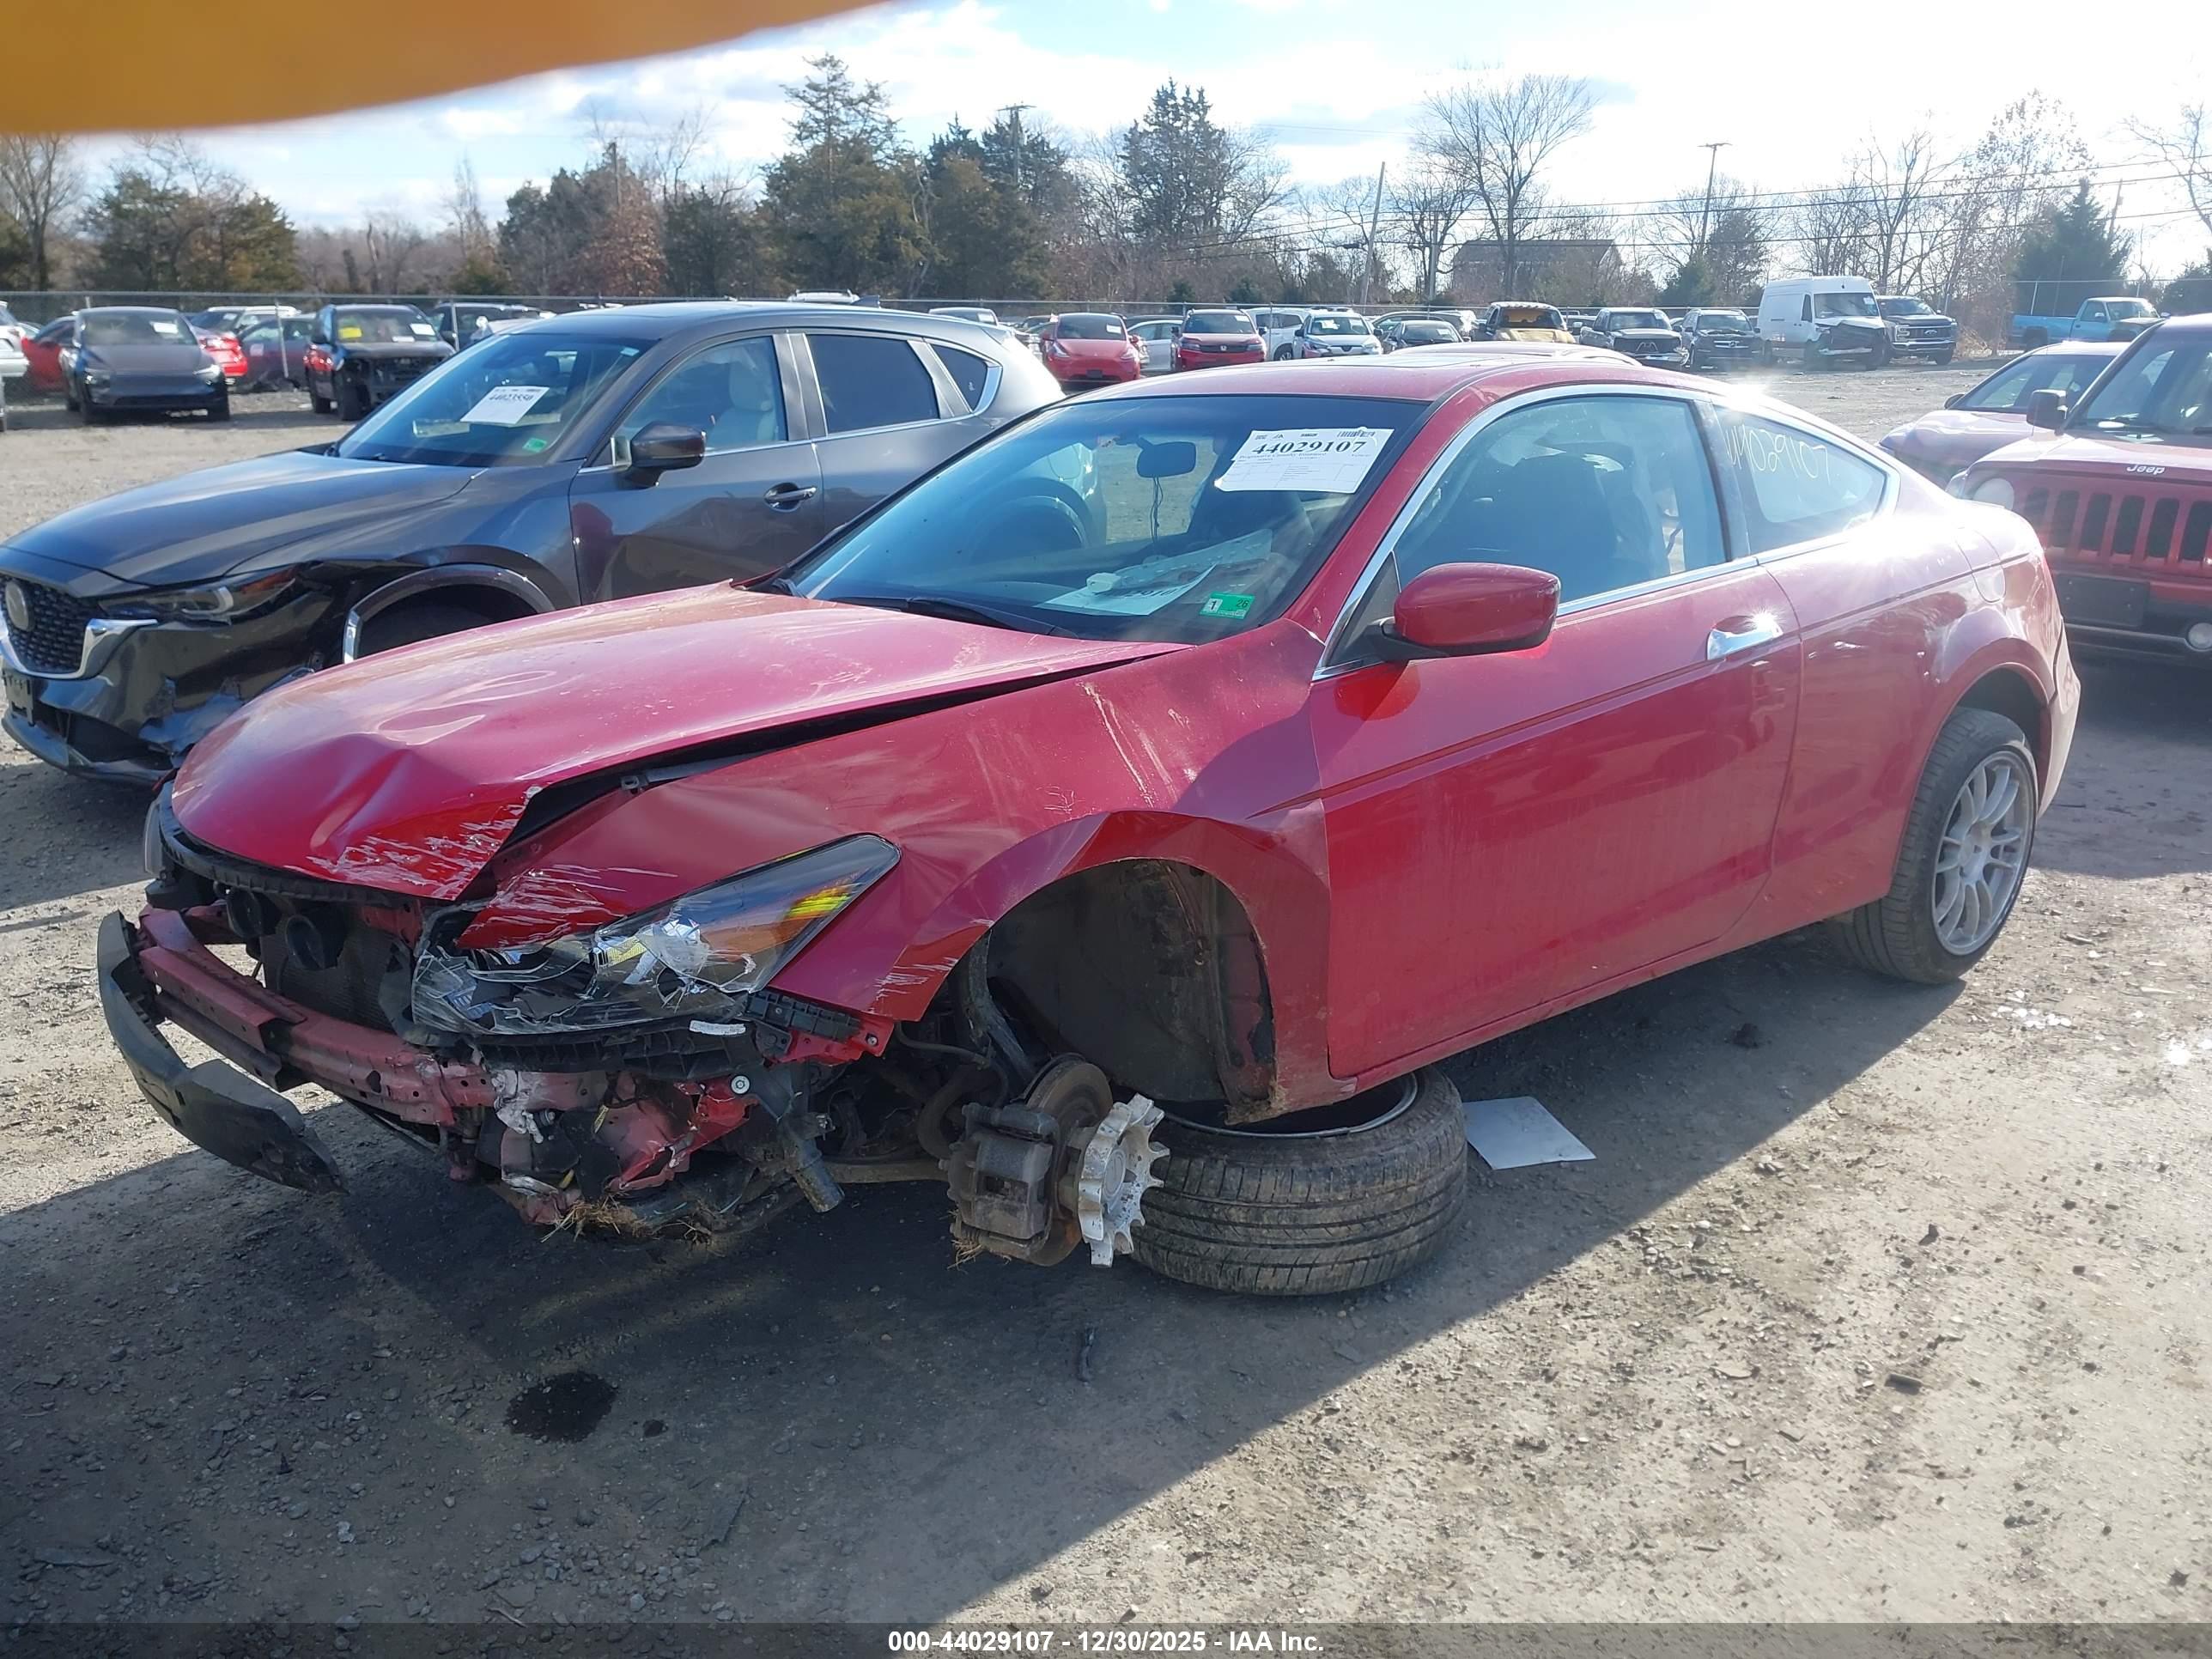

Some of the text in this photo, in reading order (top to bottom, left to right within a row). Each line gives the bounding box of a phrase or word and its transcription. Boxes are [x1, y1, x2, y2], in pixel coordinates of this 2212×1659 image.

[1253, 441, 1366, 454] 44029107
[2126, 464, 2166, 475] Jeep
[1211, 599, 1249, 610] 1 26
